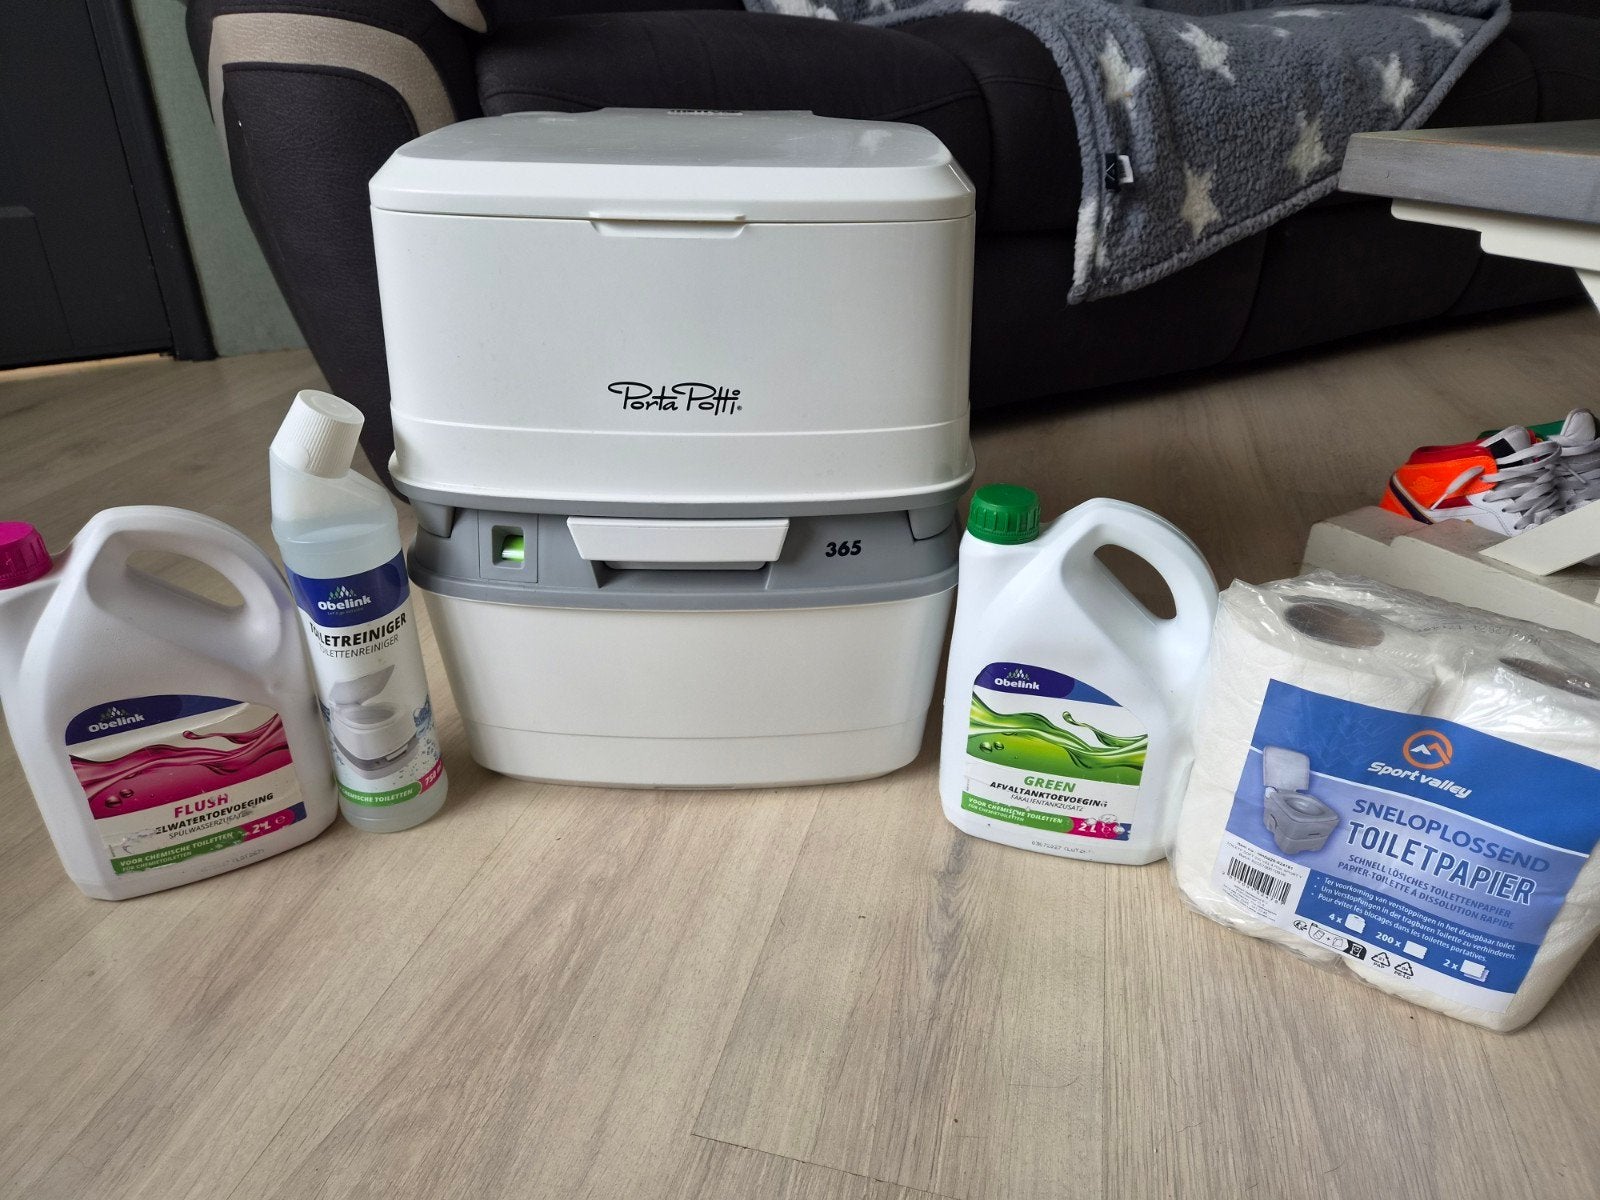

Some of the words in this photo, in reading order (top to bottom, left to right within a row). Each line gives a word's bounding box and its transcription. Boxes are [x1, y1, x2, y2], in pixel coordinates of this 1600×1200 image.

[607, 381, 679, 411] Porta
[671, 382, 741, 416] Potti
[825, 539, 862, 558] 365
[317, 594, 372, 611] Obelink
[309, 612, 407, 647] TOILETREINIGER
[994, 677, 1040, 691] Obelink
[88, 713, 145, 733] Obelink
[374, 788, 413, 803] TOILETTEN
[1023, 775, 1076, 793] GREEN
[154, 792, 274, 835] ELWATERTOEVOEGING
[174, 793, 229, 818] FLUSH
[968, 797, 987, 808] VOOR
[987, 803, 1026, 817] CHEMISCHE
[1026, 812, 1063, 824] TOILETTEN
[252, 824, 260, 834] 2
[1078, 820, 1087, 832] 2
[1352, 799, 1550, 873] SNELOPLOSSEND
[120, 857, 143, 867] VOOR
[144, 844, 191, 861] CHEMISCHE
[191, 832, 234, 849] TOILETTEN
[1346, 820, 1537, 906] TOILETPAPIER
[1337, 861, 1410, 894] PAPIER-TOILETTE
[1418, 892, 1480, 920] DISSOLUTION
[1480, 914, 1516, 930] RAPIDE
[1348, 854, 1386, 873] SCHNELL
[1387, 867, 1429, 890] LÖSICHES
[1429, 885, 1511, 918] TOILETTENPAPIER
[1321, 885, 1333, 895] Um
[1333, 889, 1381, 911] Verstopfungen
[1381, 906, 1389, 915] in
[1389, 910, 1402, 920] der
[1402, 915, 1436, 934] tragbaren
[1436, 928, 1462, 944] Toilette
[1462, 939, 1472, 947] zu
[1472, 943, 1516, 960] verhinderen.
[1324, 877, 1334, 886] Ter
[1335, 882, 1375, 900] voorkoming
[1375, 896, 1388, 905] van
[1388, 900, 1436, 925] verstoppingen
[1437, 919, 1445, 927] in
[1445, 923, 1458, 933] het
[1458, 928, 1495, 945] draagbaar
[1496, 940, 1516, 951] toilet.
[1328, 913, 1335, 921] 4
[1336, 916, 1343, 924] x
[1317, 893, 1333, 903] Pour
[1353, 905, 1363, 914] les
[1364, 910, 1393, 926] blocages
[1393, 922, 1410, 934] dans
[1410, 929, 1420, 938] les
[1421, 933, 1450, 949] toilettes
[1450, 944, 1487, 962] portatives.
[1375, 931, 1394, 944] 200
[1394, 940, 1402, 948] x
[1442, 958, 1451, 967] 2
